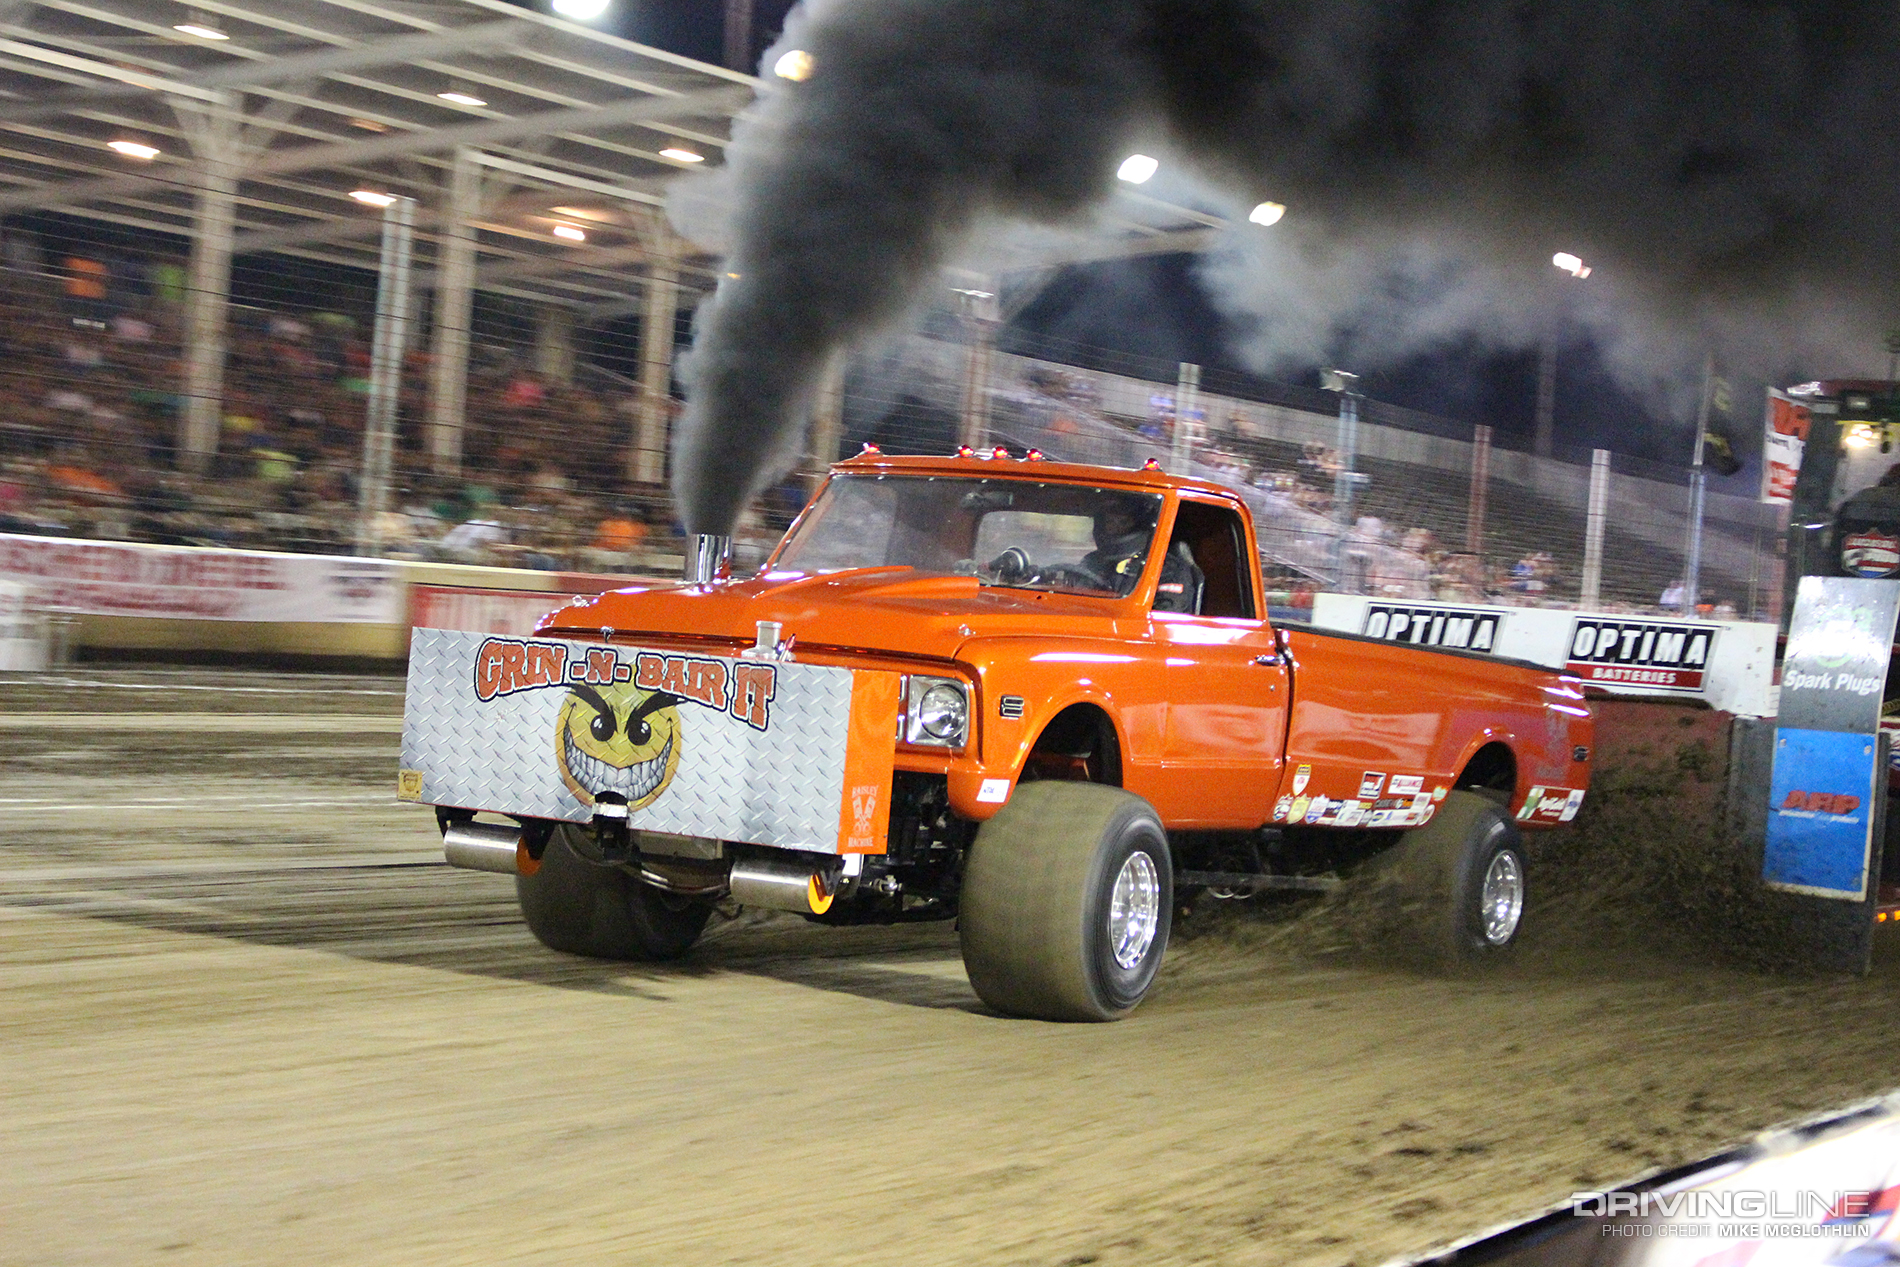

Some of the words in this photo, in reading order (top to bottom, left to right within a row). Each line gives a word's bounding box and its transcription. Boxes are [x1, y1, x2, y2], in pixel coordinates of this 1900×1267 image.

[1365, 611, 1494, 651] OPTIMA
[1572, 626, 1708, 665] OPTIMA
[475, 638, 567, 701] GRIN
[635, 653, 729, 711] BAIR
[731, 663, 777, 731] IT
[1593, 667, 1677, 684] BATTERIES
[1783, 669, 1831, 691] Spark
[1835, 673, 1881, 696] Plugs
[1782, 790, 1861, 814] ARP
